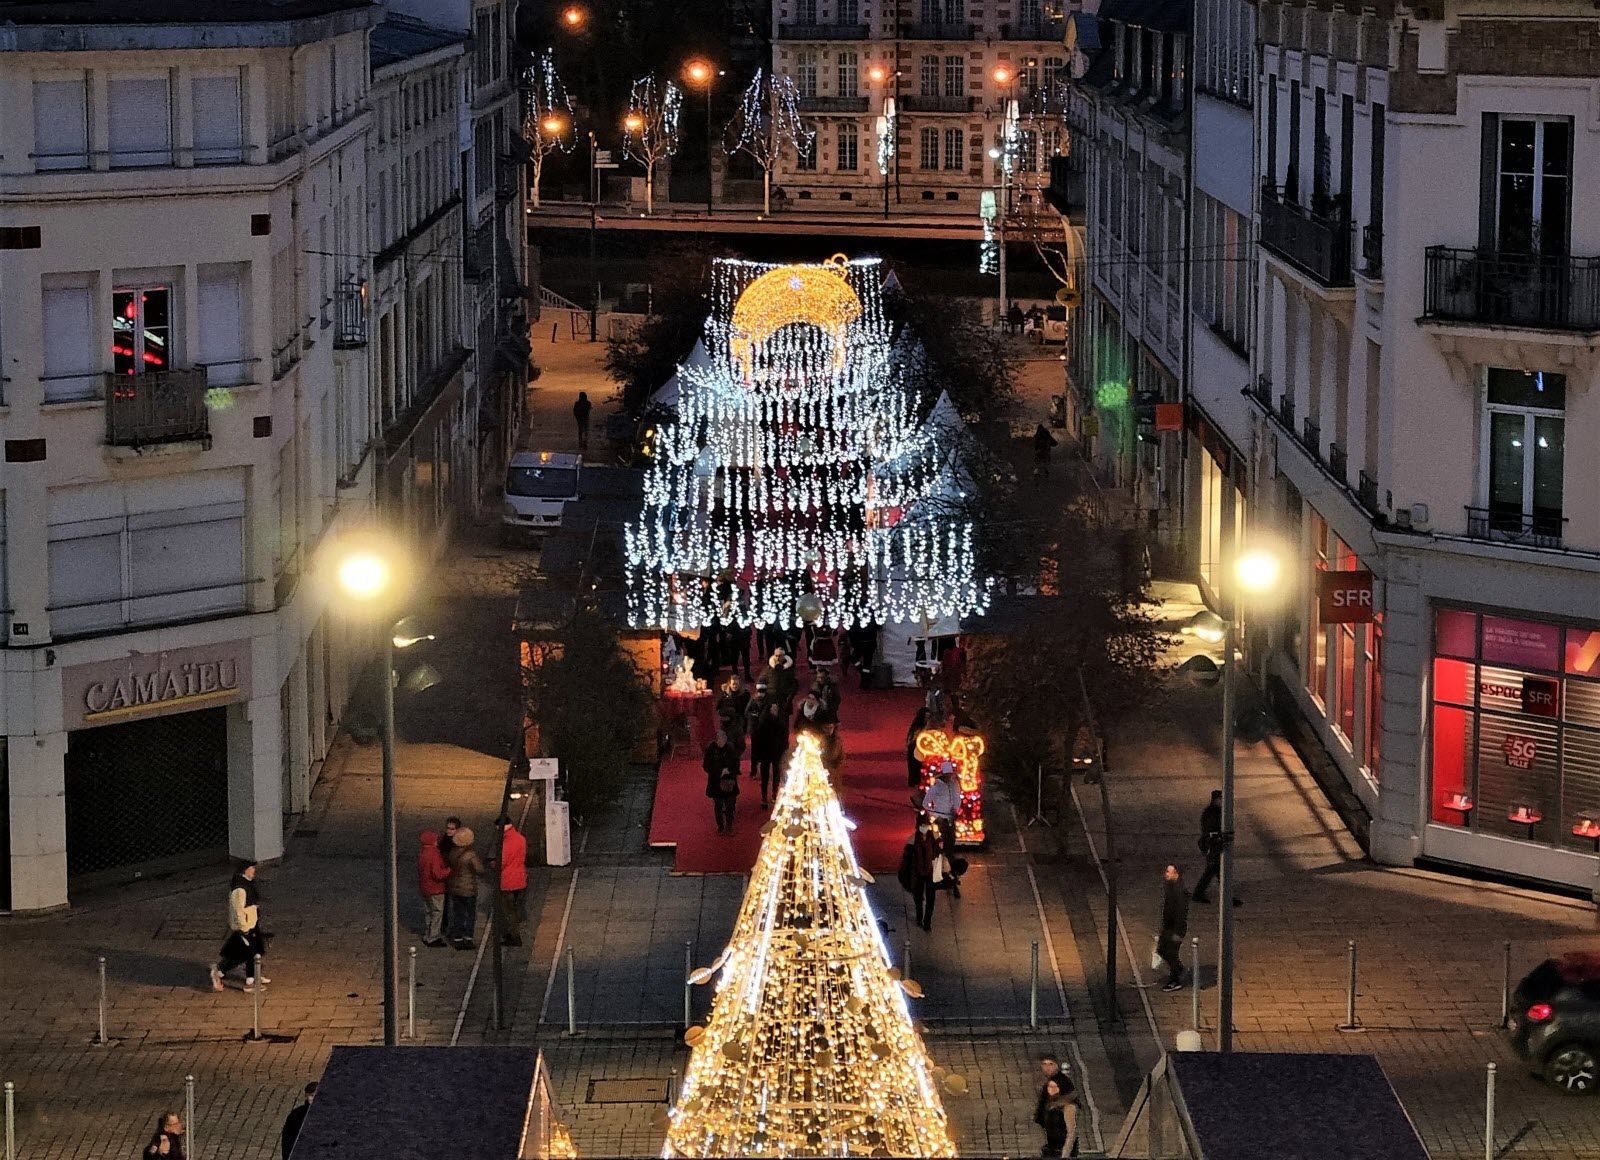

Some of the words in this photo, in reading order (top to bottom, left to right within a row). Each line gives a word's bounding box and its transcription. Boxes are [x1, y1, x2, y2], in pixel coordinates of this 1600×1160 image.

[1333, 589, 1371, 607] SFR
[1480, 684, 1522, 700] espac
[1529, 690, 1552, 704] SFR
[1511, 740, 1535, 758] 5G
[1508, 759, 1528, 768] VILLE
